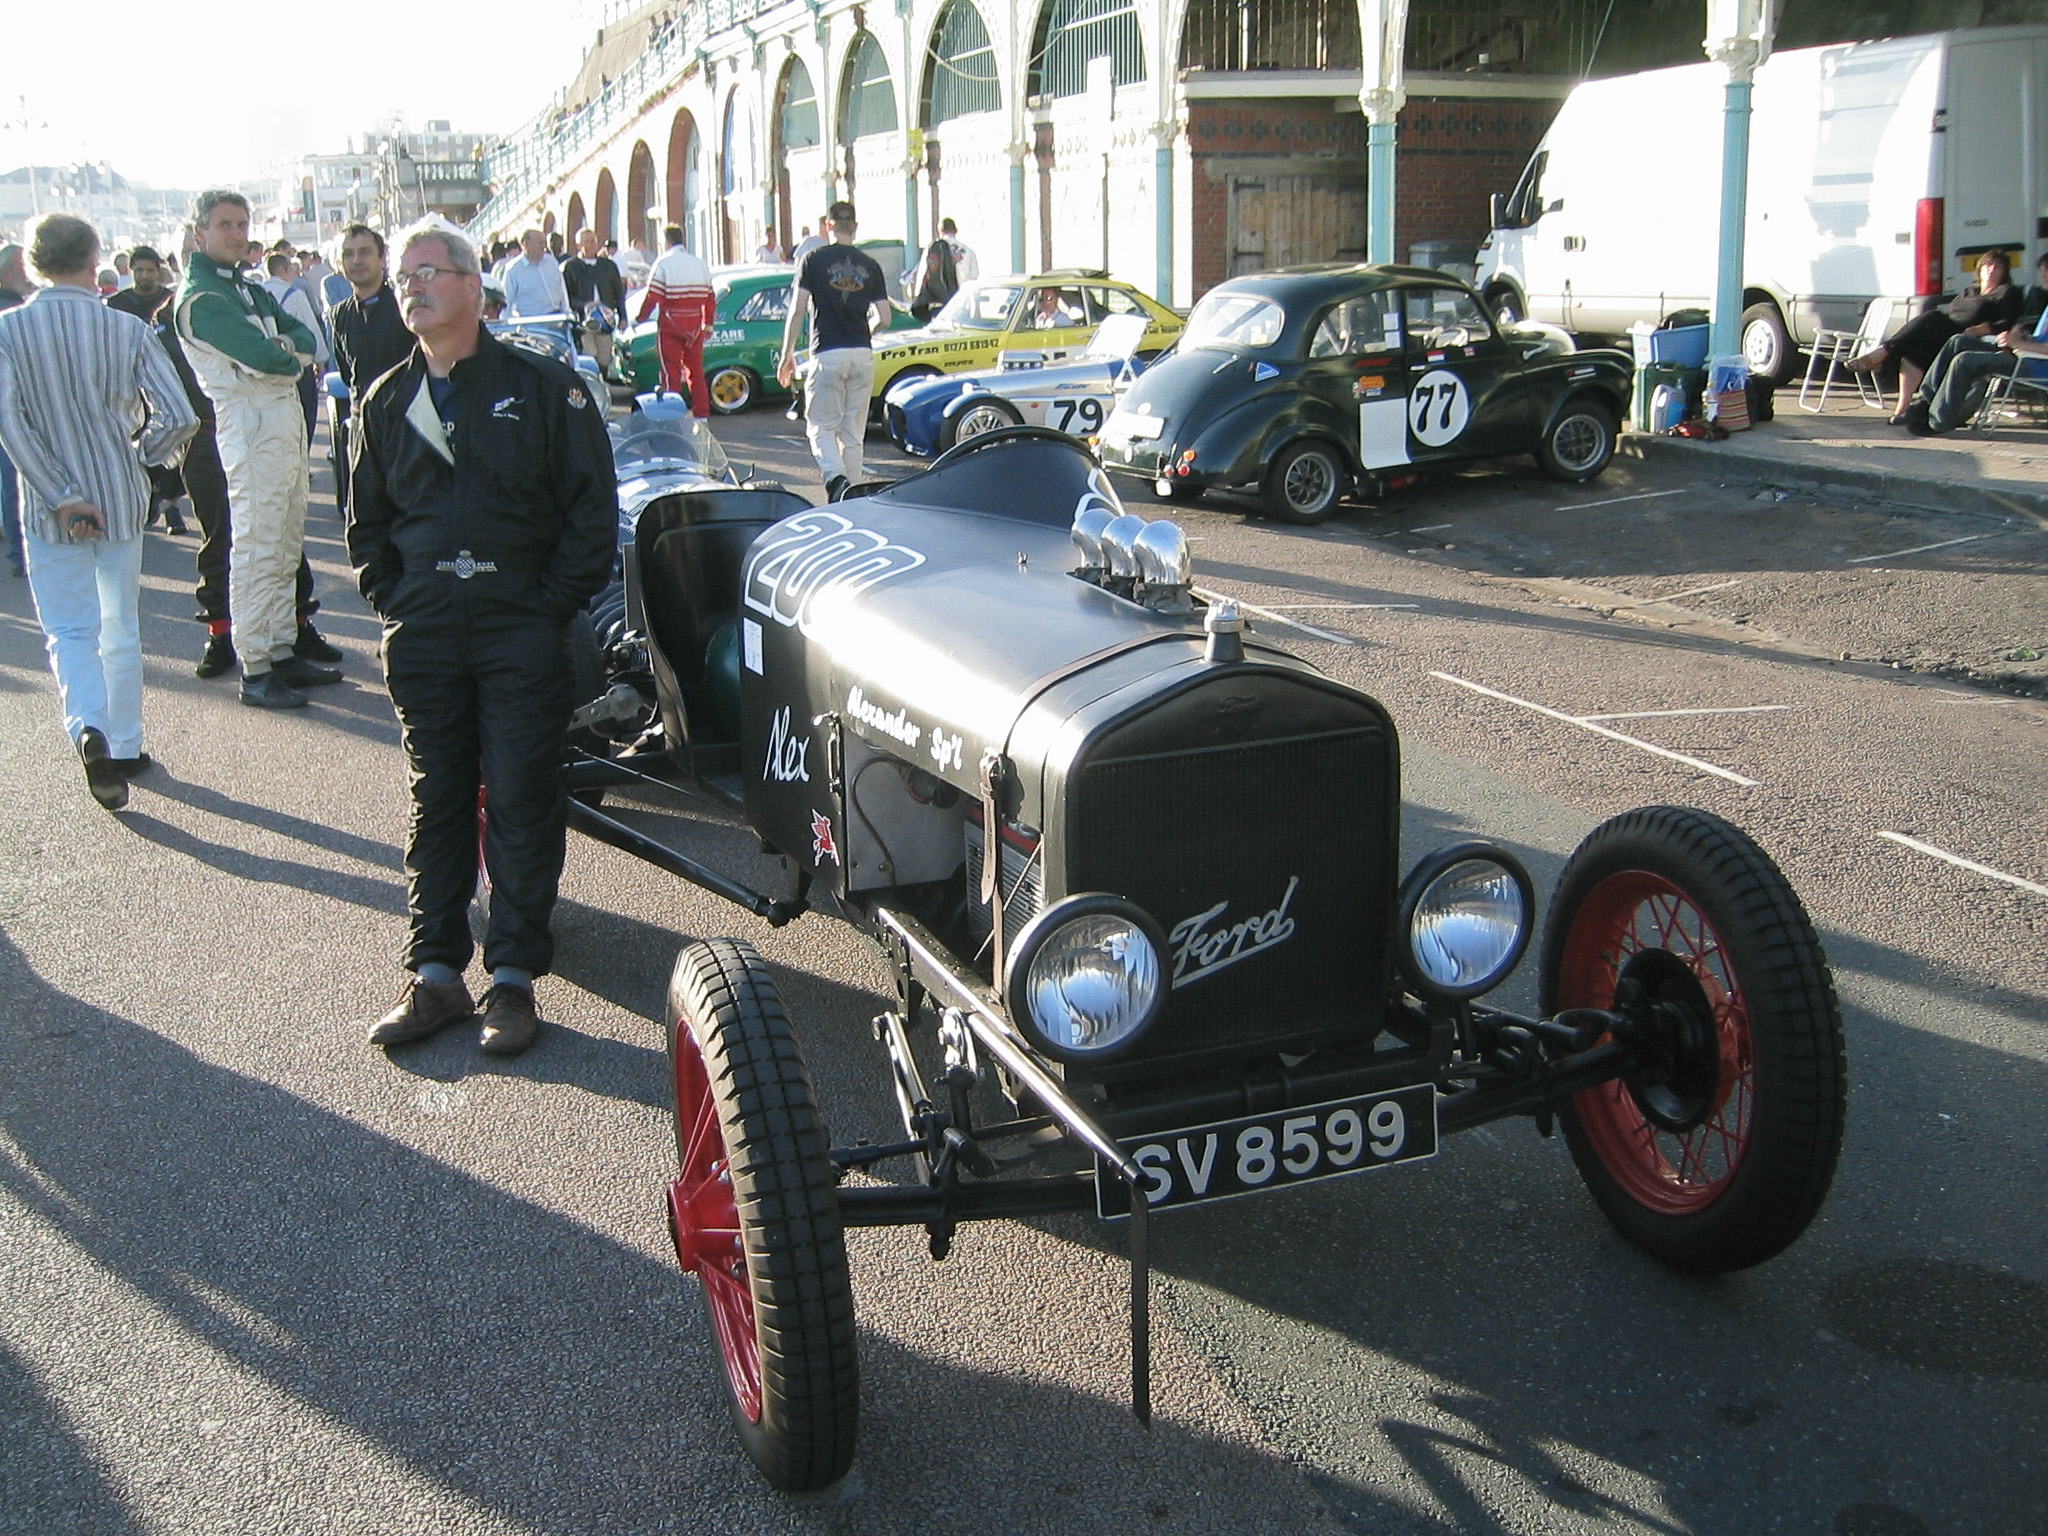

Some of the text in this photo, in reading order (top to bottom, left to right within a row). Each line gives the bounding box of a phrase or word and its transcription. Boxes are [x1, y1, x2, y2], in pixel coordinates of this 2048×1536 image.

[881, 350, 906, 361] Pro
[908, 346, 940, 356] Tran
[1053, 398, 1104, 433] 79
[1415, 382, 1457, 433] 77
[763, 705, 811, 782] Alex
[847, 685, 921, 748] Alexander
[1169, 876, 1299, 991] Ford
[1132, 1100, 1405, 1203] SV 8599
